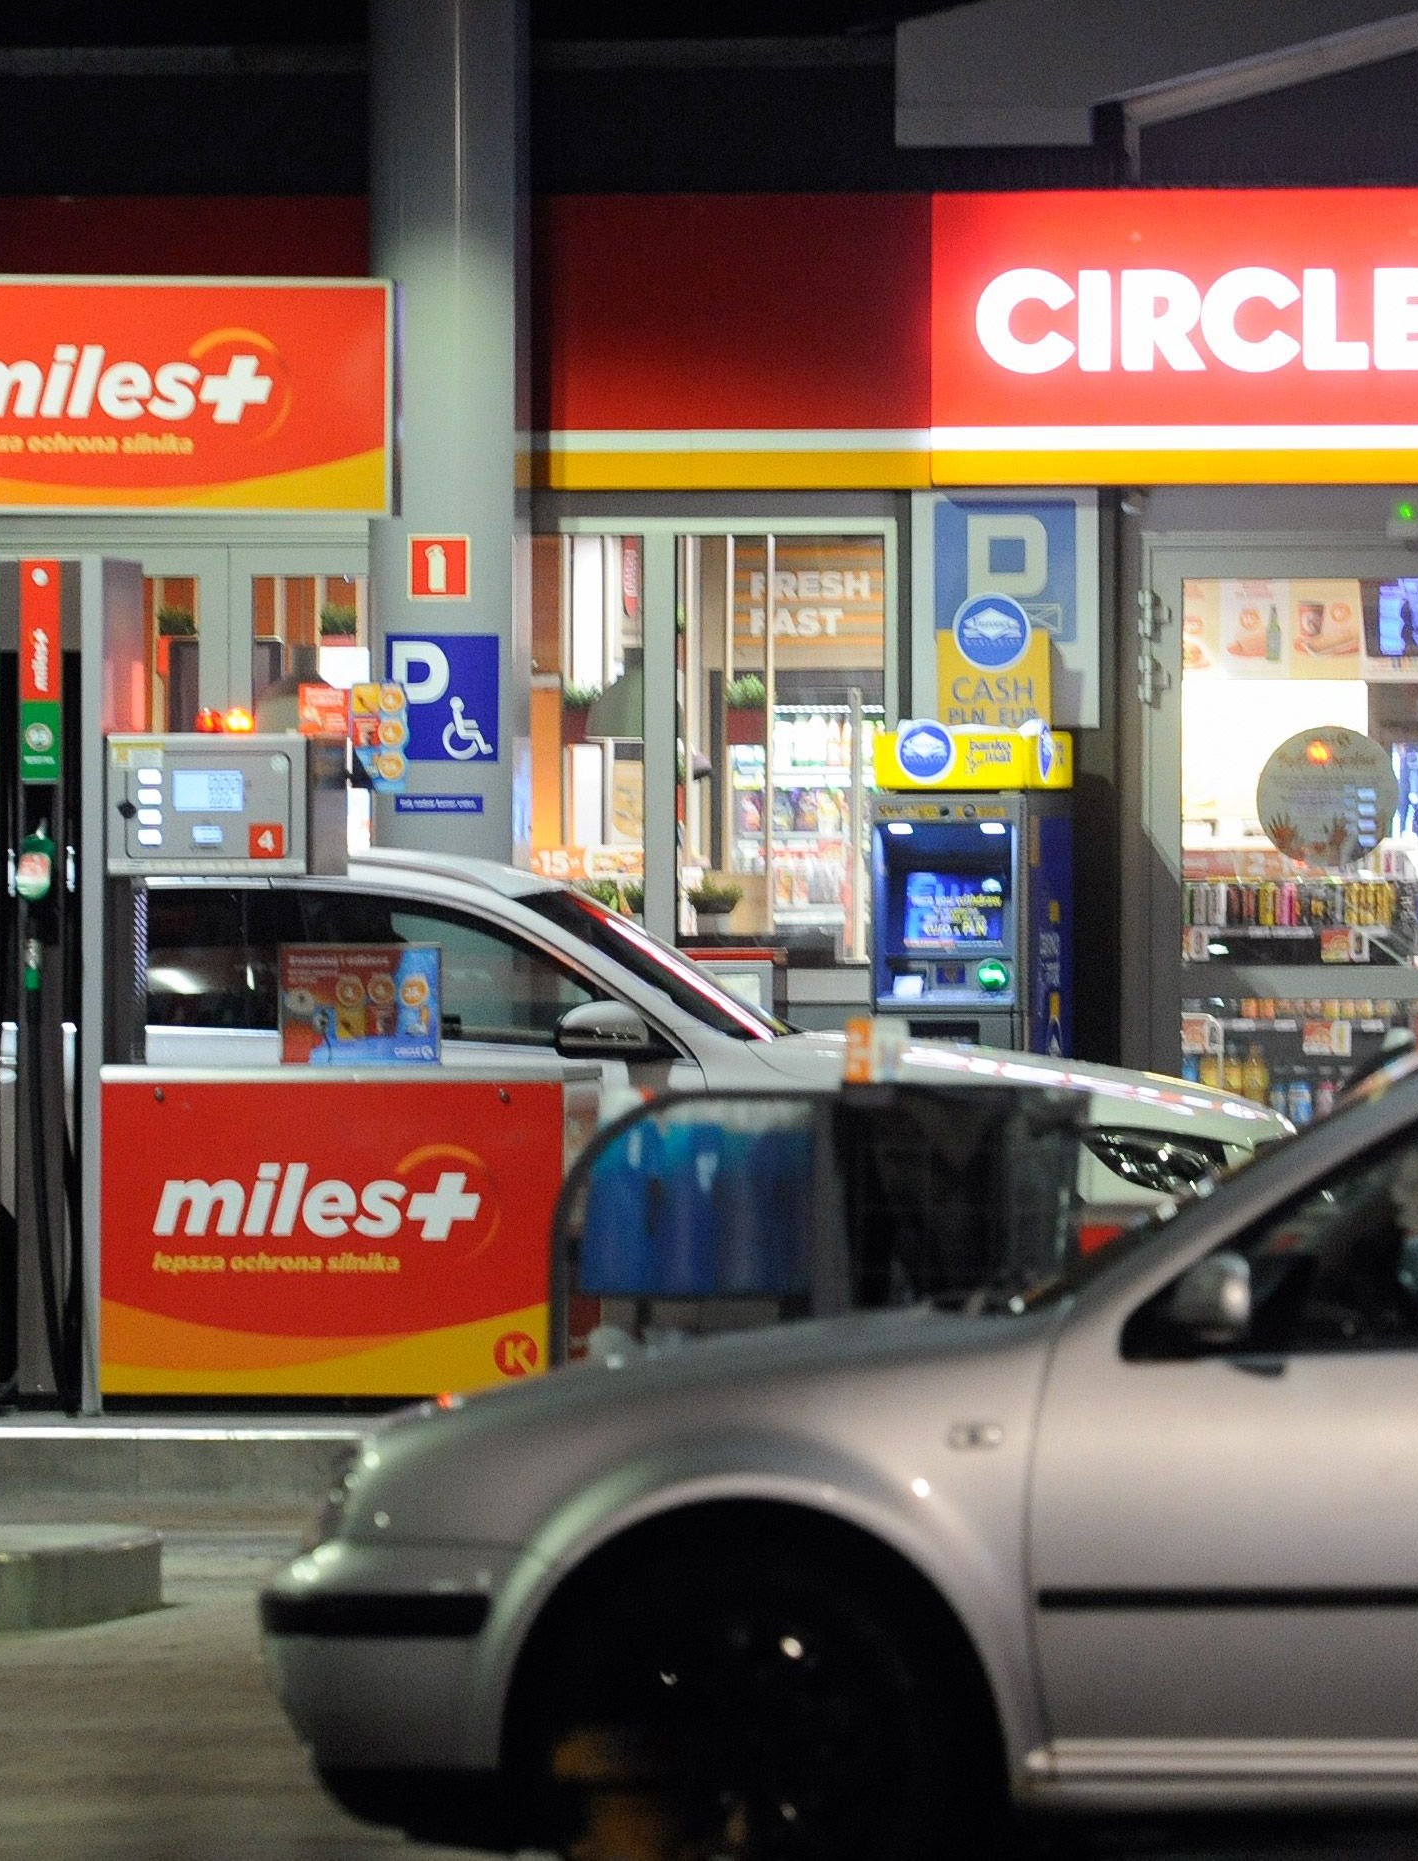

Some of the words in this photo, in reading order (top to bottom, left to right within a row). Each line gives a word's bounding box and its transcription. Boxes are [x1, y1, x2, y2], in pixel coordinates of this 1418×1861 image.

[28, 432, 118, 453] ochrona
[122, 432, 193, 454] silnika
[750, 570, 870, 600] FRESH
[749, 606, 844, 637] FAST
[392, 640, 448, 704] P
[952, 676, 1035, 705] CASH
[949, 707, 985, 724] PLN
[256, 829, 276, 853] 4
[153, 1163, 480, 1240] miles+
[153, 1252, 225, 1275] lepsza
[231, 1252, 322, 1273] ochrona
[327, 1252, 400, 1272] silnika
